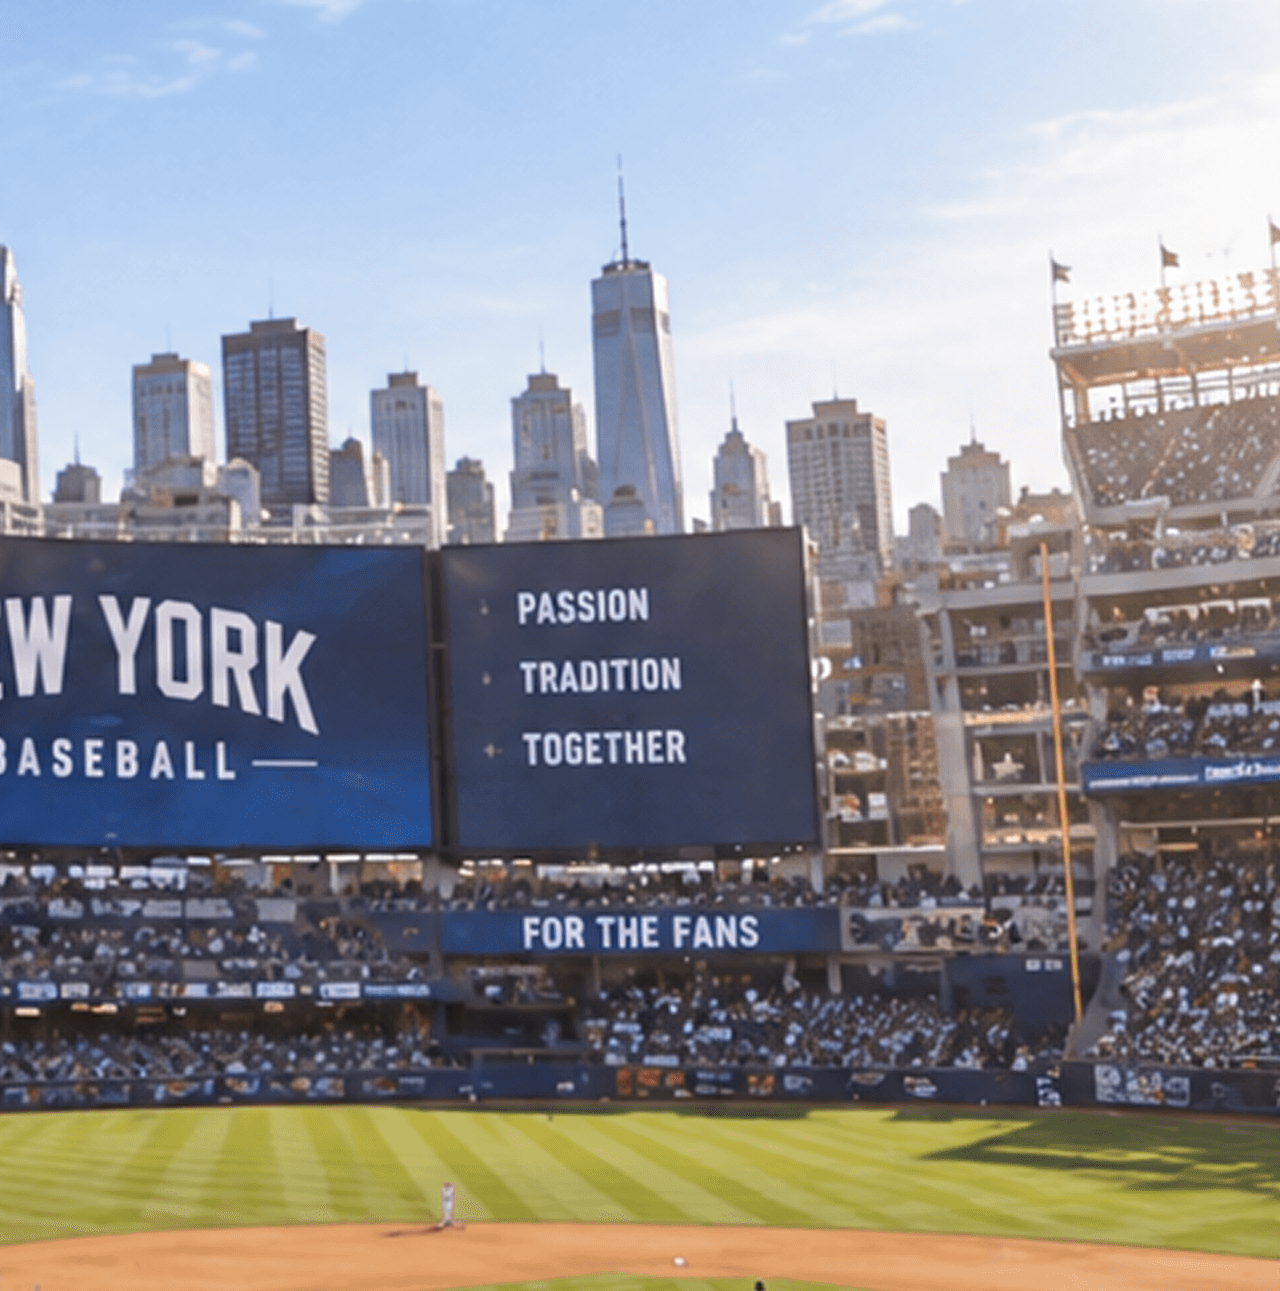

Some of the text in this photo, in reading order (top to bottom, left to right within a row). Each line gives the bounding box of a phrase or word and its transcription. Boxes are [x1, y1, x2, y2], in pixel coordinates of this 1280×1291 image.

[517, 588, 649, 625] PASSION
[98, 594, 320, 735] YORK
[520, 657, 682, 694] TRADITION
[522, 729, 687, 766] TOGETHER
[523, 914, 759, 949] FOR THE FANS
